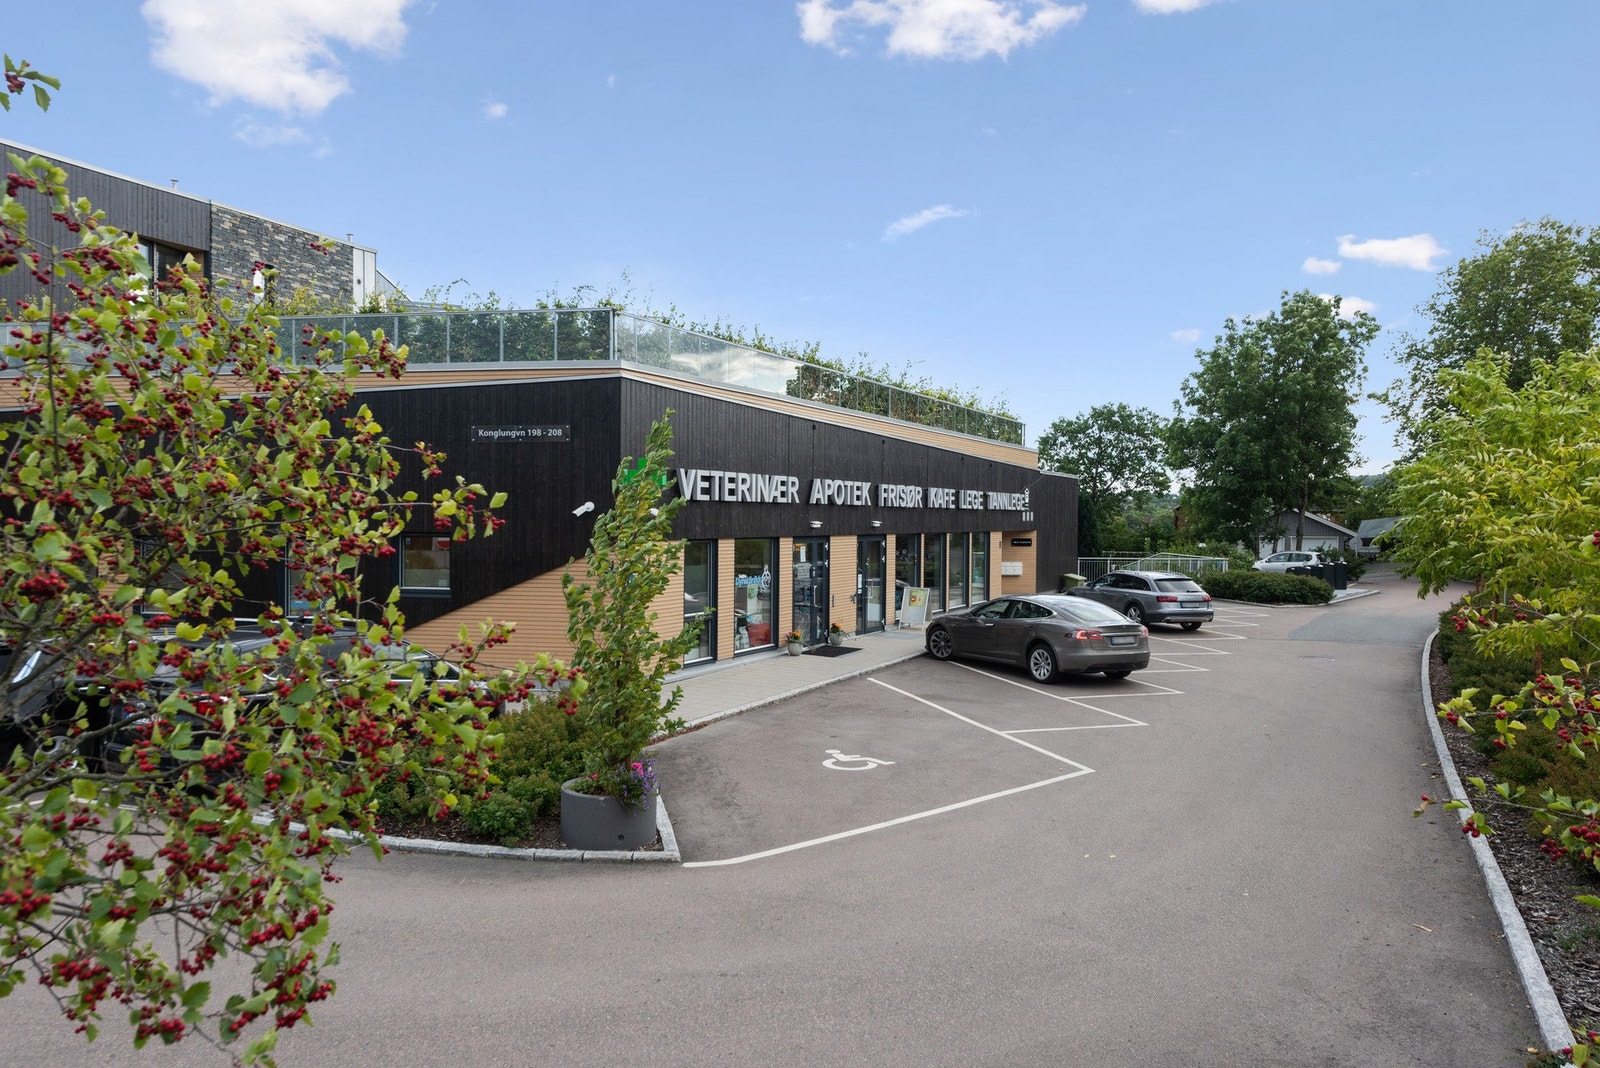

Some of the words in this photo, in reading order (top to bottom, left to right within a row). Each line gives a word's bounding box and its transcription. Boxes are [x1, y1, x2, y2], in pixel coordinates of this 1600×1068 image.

[478, 429, 525, 438] Konglungvn
[678, 468, 800, 504] VETERINÆR
[809, 478, 872, 506] APOTEK
[878, 483, 923, 508] FRISØR
[928, 487, 956, 509] KAFE
[959, 490, 984, 510] LEGE
[986, 491, 1025, 511] TANNLEGE
